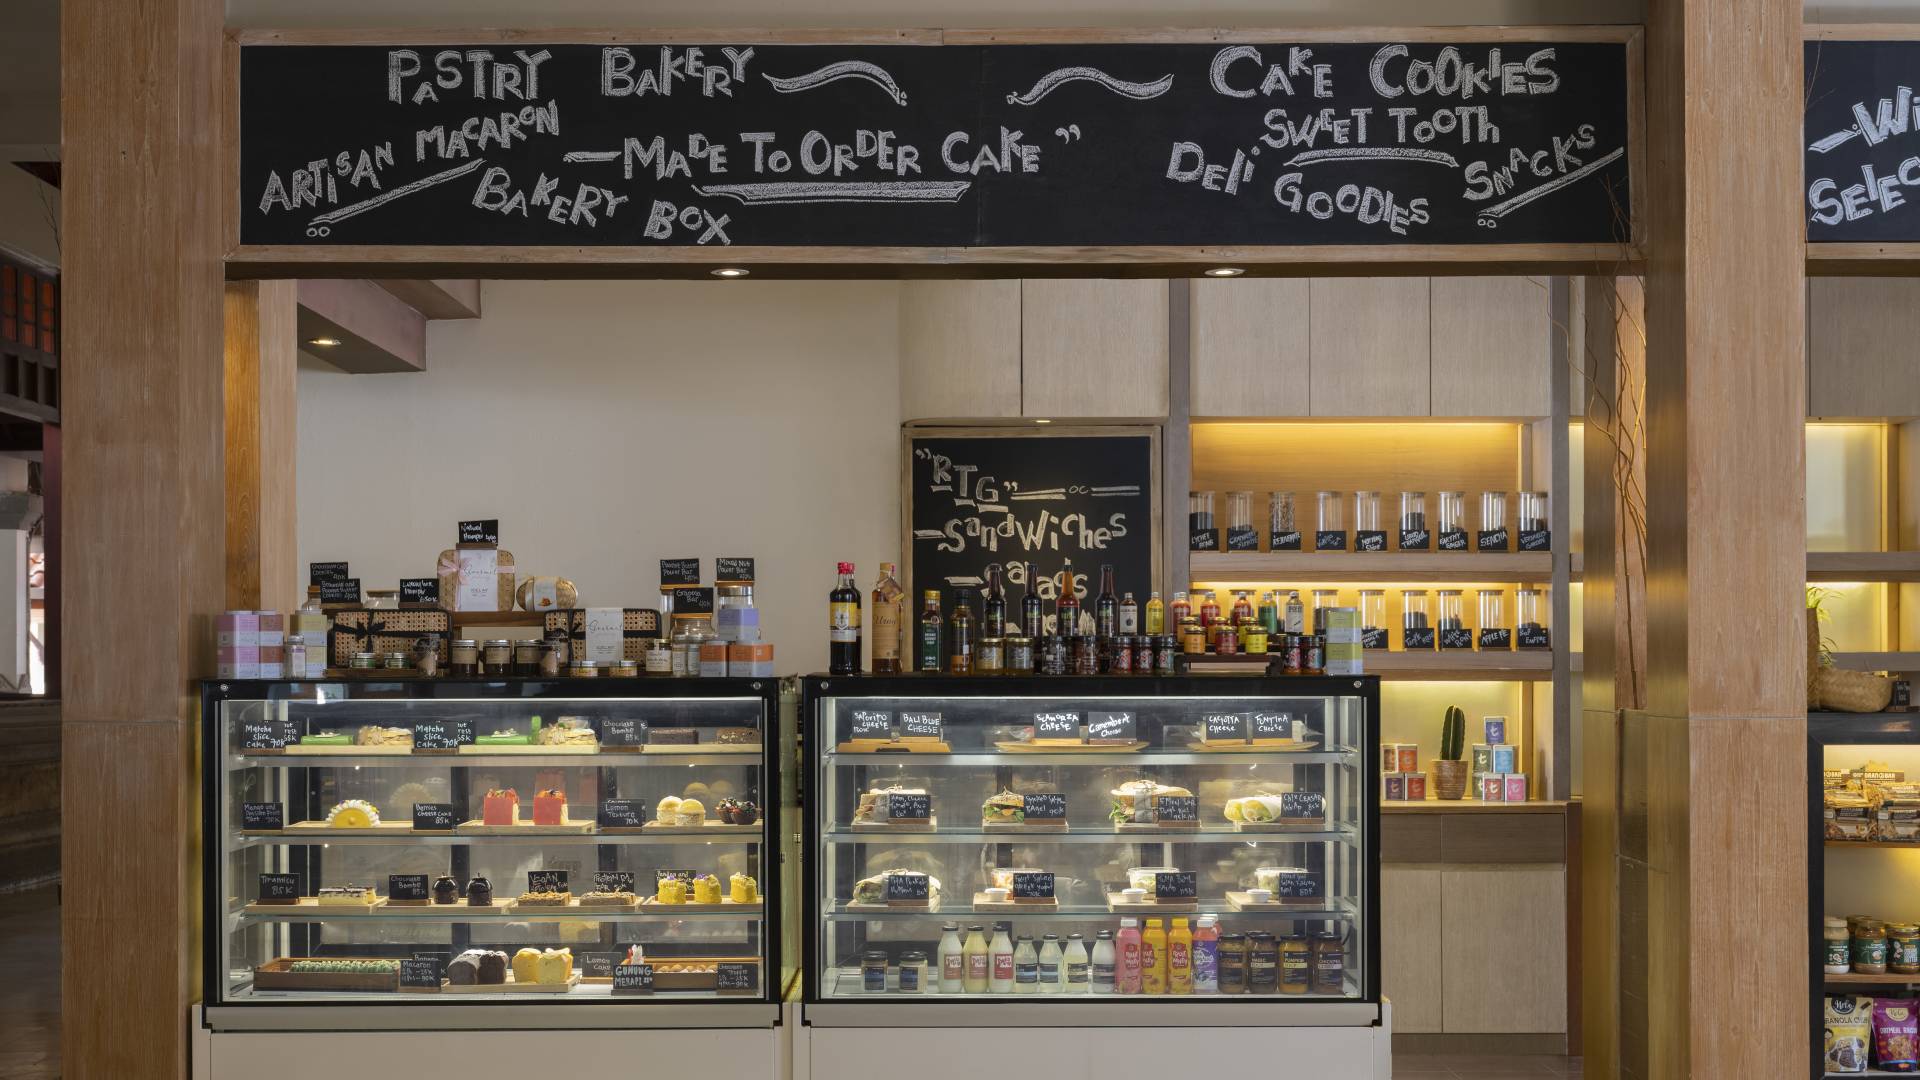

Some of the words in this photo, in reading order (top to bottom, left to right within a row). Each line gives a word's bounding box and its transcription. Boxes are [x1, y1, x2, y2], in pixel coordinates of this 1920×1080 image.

[388, 49, 551, 104] PASTRY
[602, 47, 754, 98] BAKERY
[1209, 45, 1333, 98] CAKE
[1370, 44, 1560, 98] COOKIES
[624, 133, 727, 180] MADE
[740, 130, 792, 173] TO
[801, 127, 922, 176] ORDER
[941, 126, 1040, 176] CAKE
[1260, 107, 1372, 148] SWEET
[259, 141, 394, 215] ARTISAN
[416, 99, 559, 162] MACARON
[1464, 124, 1596, 200] SNACKS
[473, 167, 628, 227] BAKERY
[643, 199, 731, 245] BOX
[1274, 172, 1429, 234] GOODIES
[245, 724, 272, 734] Matcha
[415, 724, 444, 734] Matcha
[907, 724, 938, 734] CHEESE
